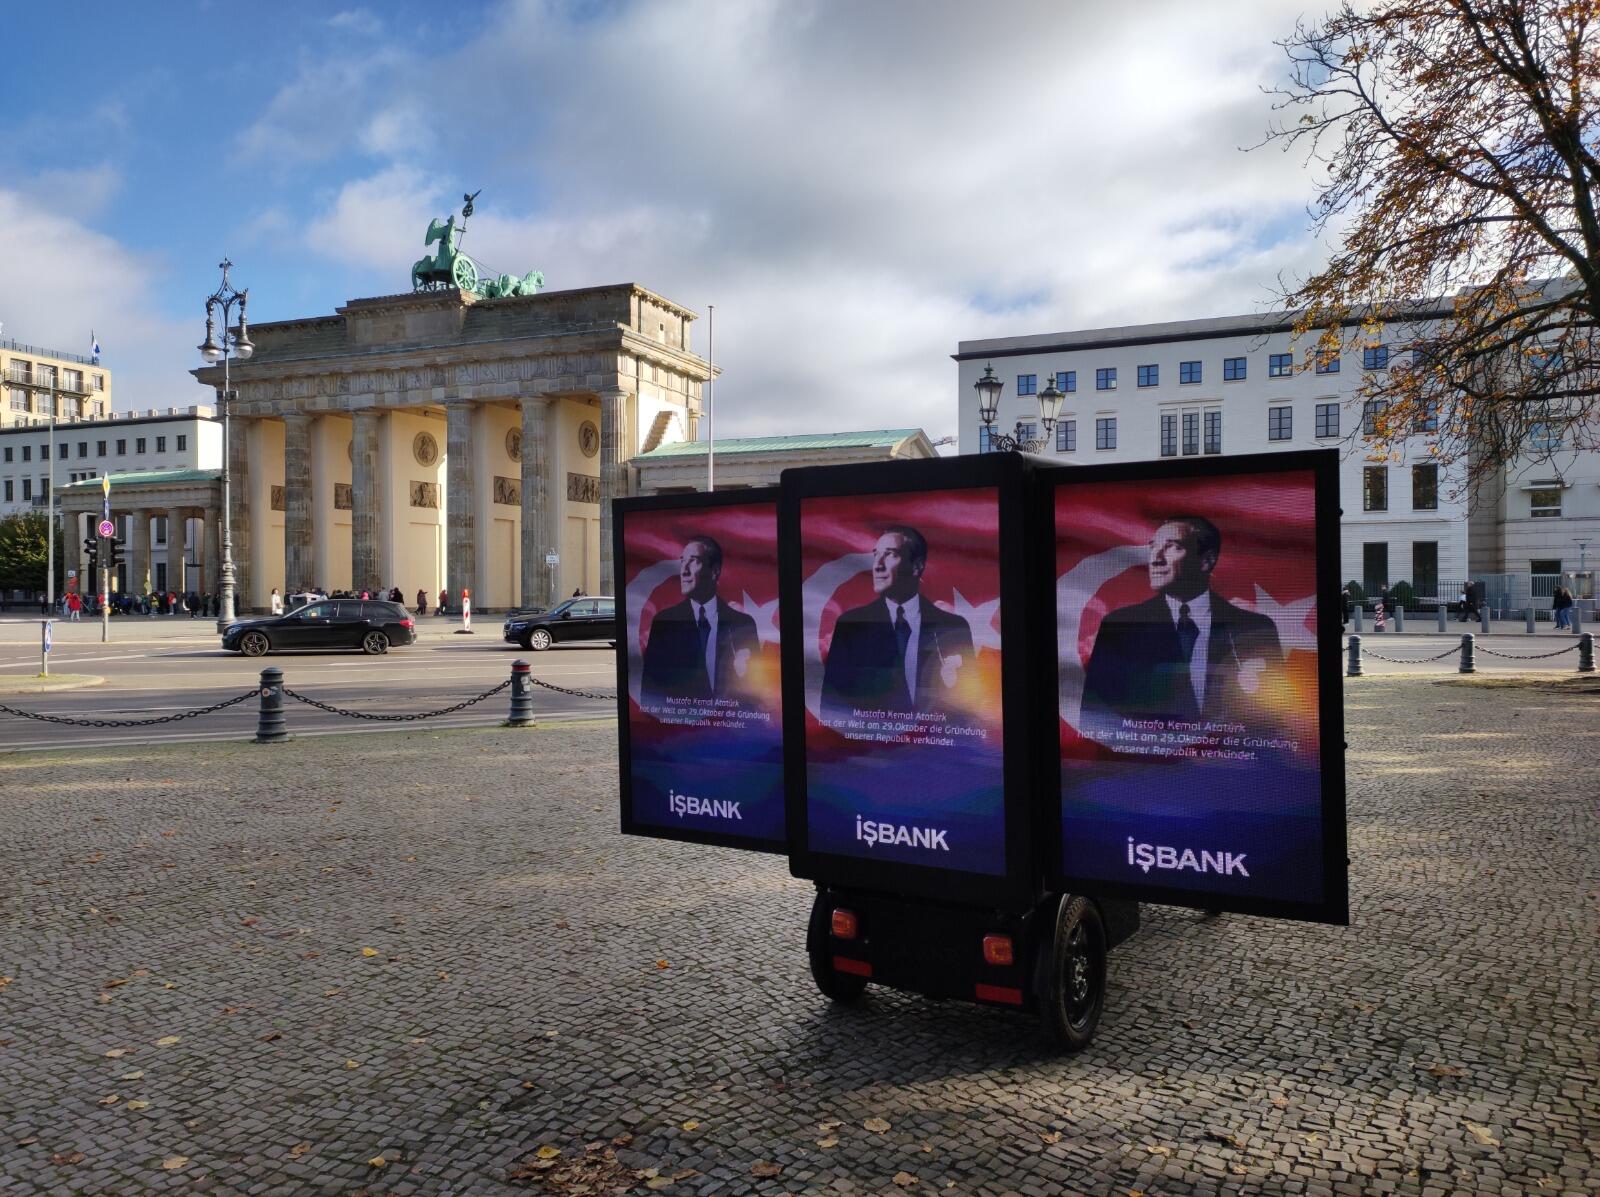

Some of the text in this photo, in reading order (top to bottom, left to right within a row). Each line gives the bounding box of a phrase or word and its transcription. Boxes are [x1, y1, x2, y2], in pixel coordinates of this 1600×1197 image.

[666, 696, 740, 708] Mustafa Kemal Atatürk
[662, 706, 676, 715] Welt
[726, 709, 736, 718] die
[853, 708, 947, 722] Mustafa Kemal Atatürk
[684, 717, 711, 727] Republik
[833, 719, 846, 728] der
[847, 719, 865, 729] Welt
[867, 722, 880, 730] am
[929, 724, 943, 734] die
[944, 725, 987, 739] Gründung
[1122, 718, 1246, 733] Mustafa Kemal Atatürk
[844, 731, 874, 741] unserer
[876, 733, 911, 744] Republik
[1077, 729, 1095, 740] hat
[1096, 729, 1114, 739] der
[1115, 730, 1138, 741] Welt
[1140, 733, 1158, 743] am
[1222, 734, 1240, 746] die
[1242, 736, 1298, 752] Gründung
[1111, 744, 1150, 755] unserer
[1152, 745, 1198, 758] Republik
[669, 788, 742, 821] İŞBANK
[856, 813, 950, 852] İŞBANK
[1127, 836, 1250, 878] İŞBANK
